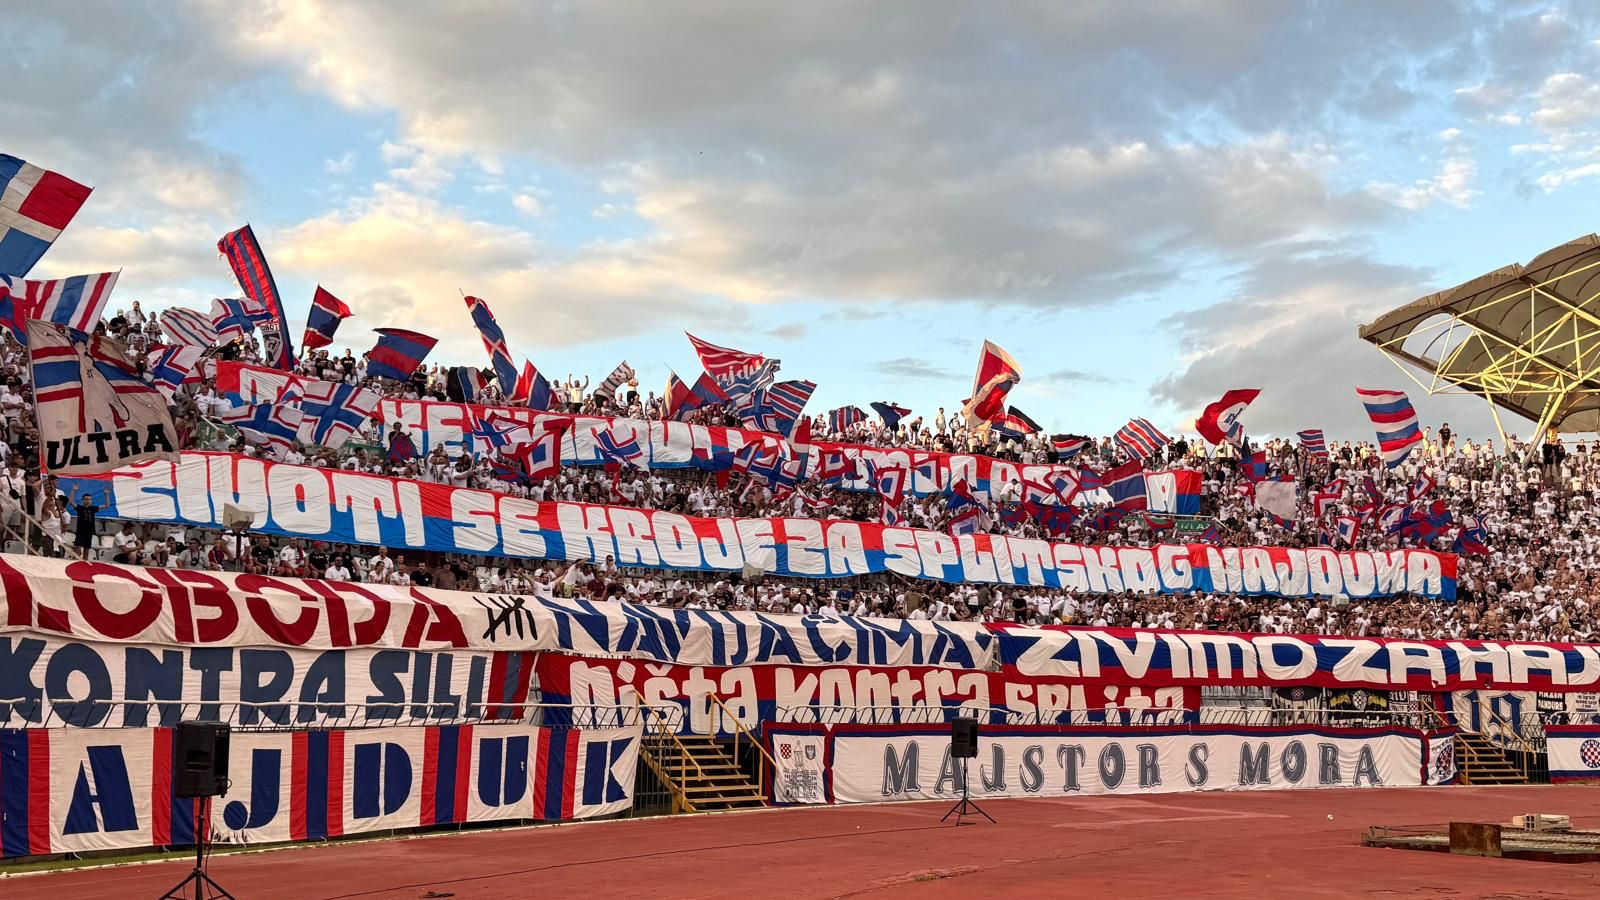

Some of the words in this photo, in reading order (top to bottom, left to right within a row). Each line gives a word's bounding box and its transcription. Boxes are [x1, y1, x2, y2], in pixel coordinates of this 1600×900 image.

[47, 423, 174, 471] ULTRA
[451, 489, 546, 557] SE
[557, 502, 777, 571] KROJE
[784, 519, 870, 574] ZA
[882, 527, 1193, 593] SPLITSKOG
[1207, 547, 1441, 596] HAJDUKA
[0, 637, 346, 728] KONTRA
[365, 650, 487, 719] SILI
[1318, 638, 1447, 686] ZA
[1446, 641, 1600, 686] HAJ
[882, 739, 1162, 797] MAJSTOR
[1184, 742, 1209, 787] S
[1238, 740, 1383, 787] MORA
